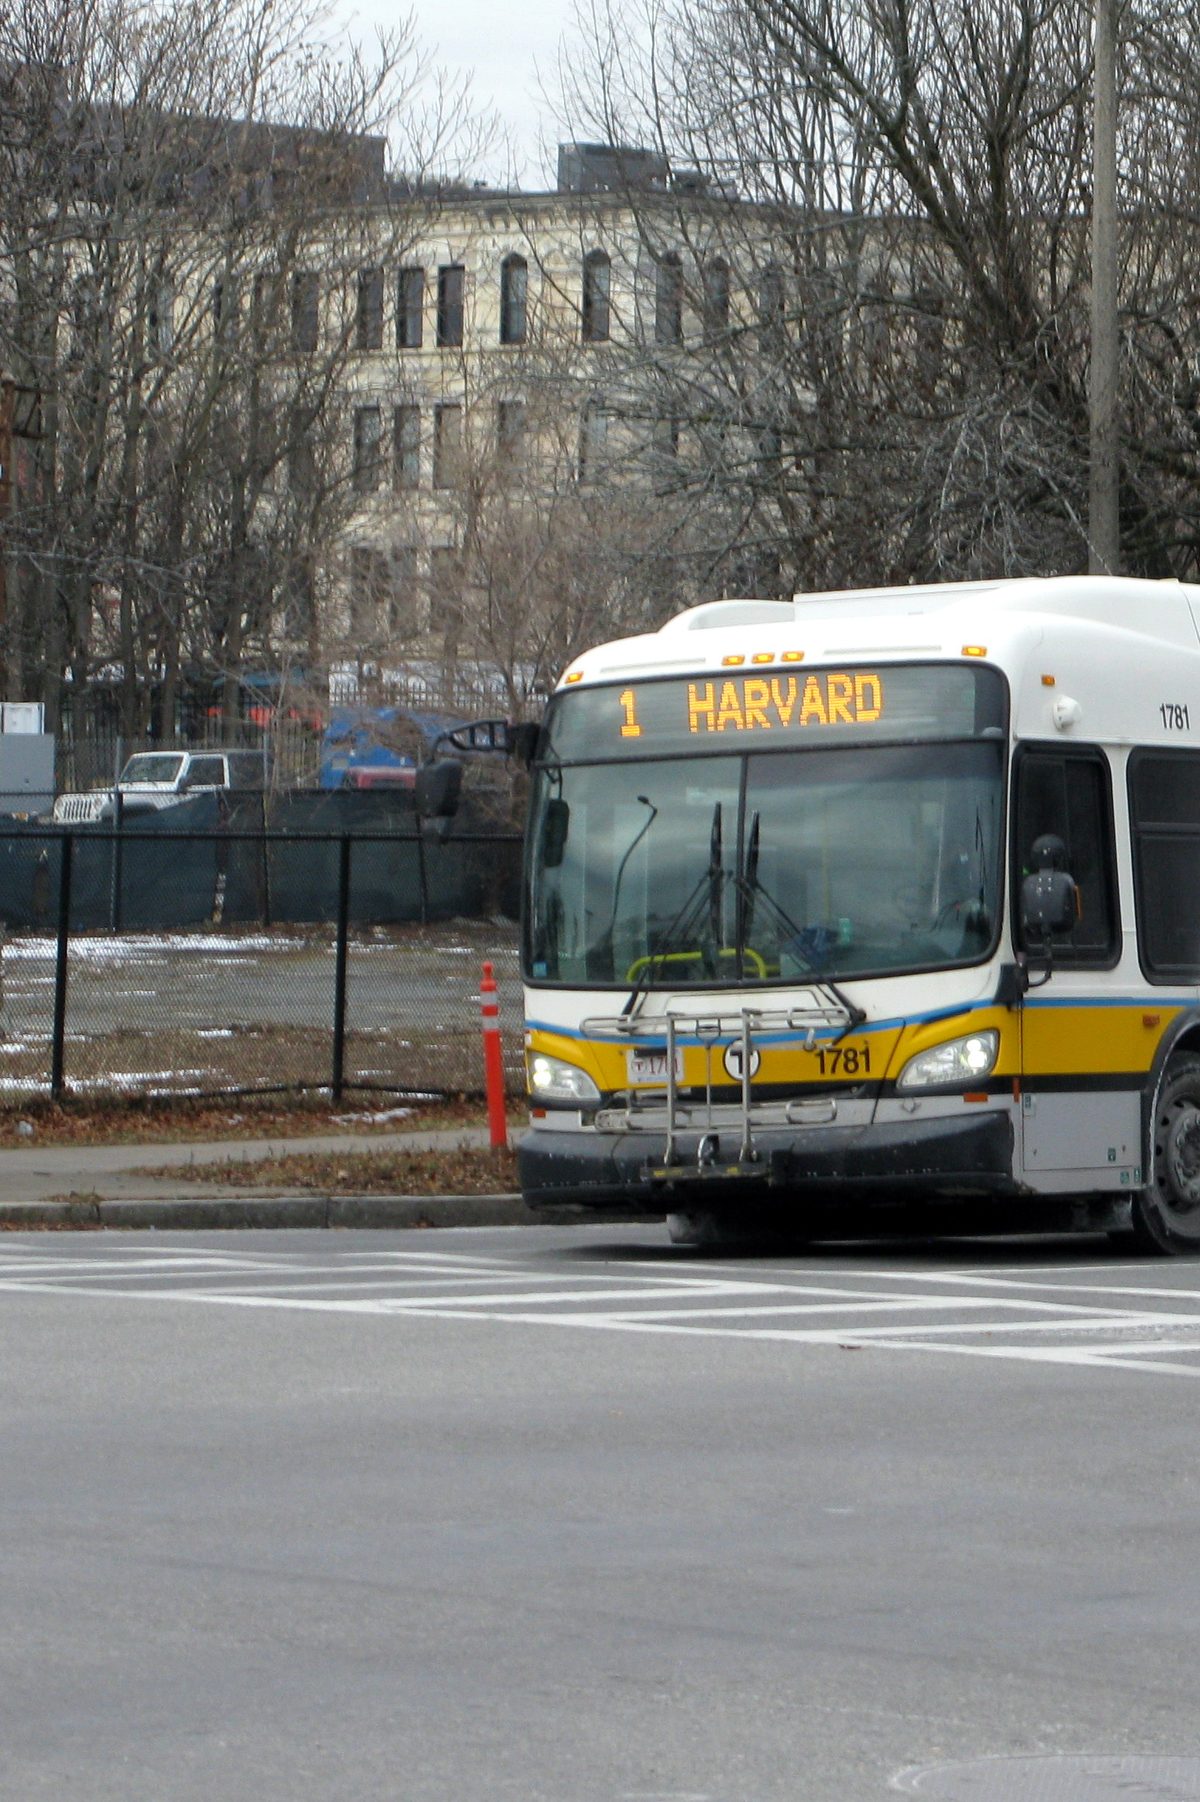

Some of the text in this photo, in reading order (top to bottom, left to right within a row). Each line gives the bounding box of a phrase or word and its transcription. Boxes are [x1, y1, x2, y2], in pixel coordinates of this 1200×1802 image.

[619, 673, 882, 737] 1 HARVARD
[1160, 703, 1190, 730] 1781
[730, 1050, 753, 1075] T
[815, 1047, 871, 1074] 1781
